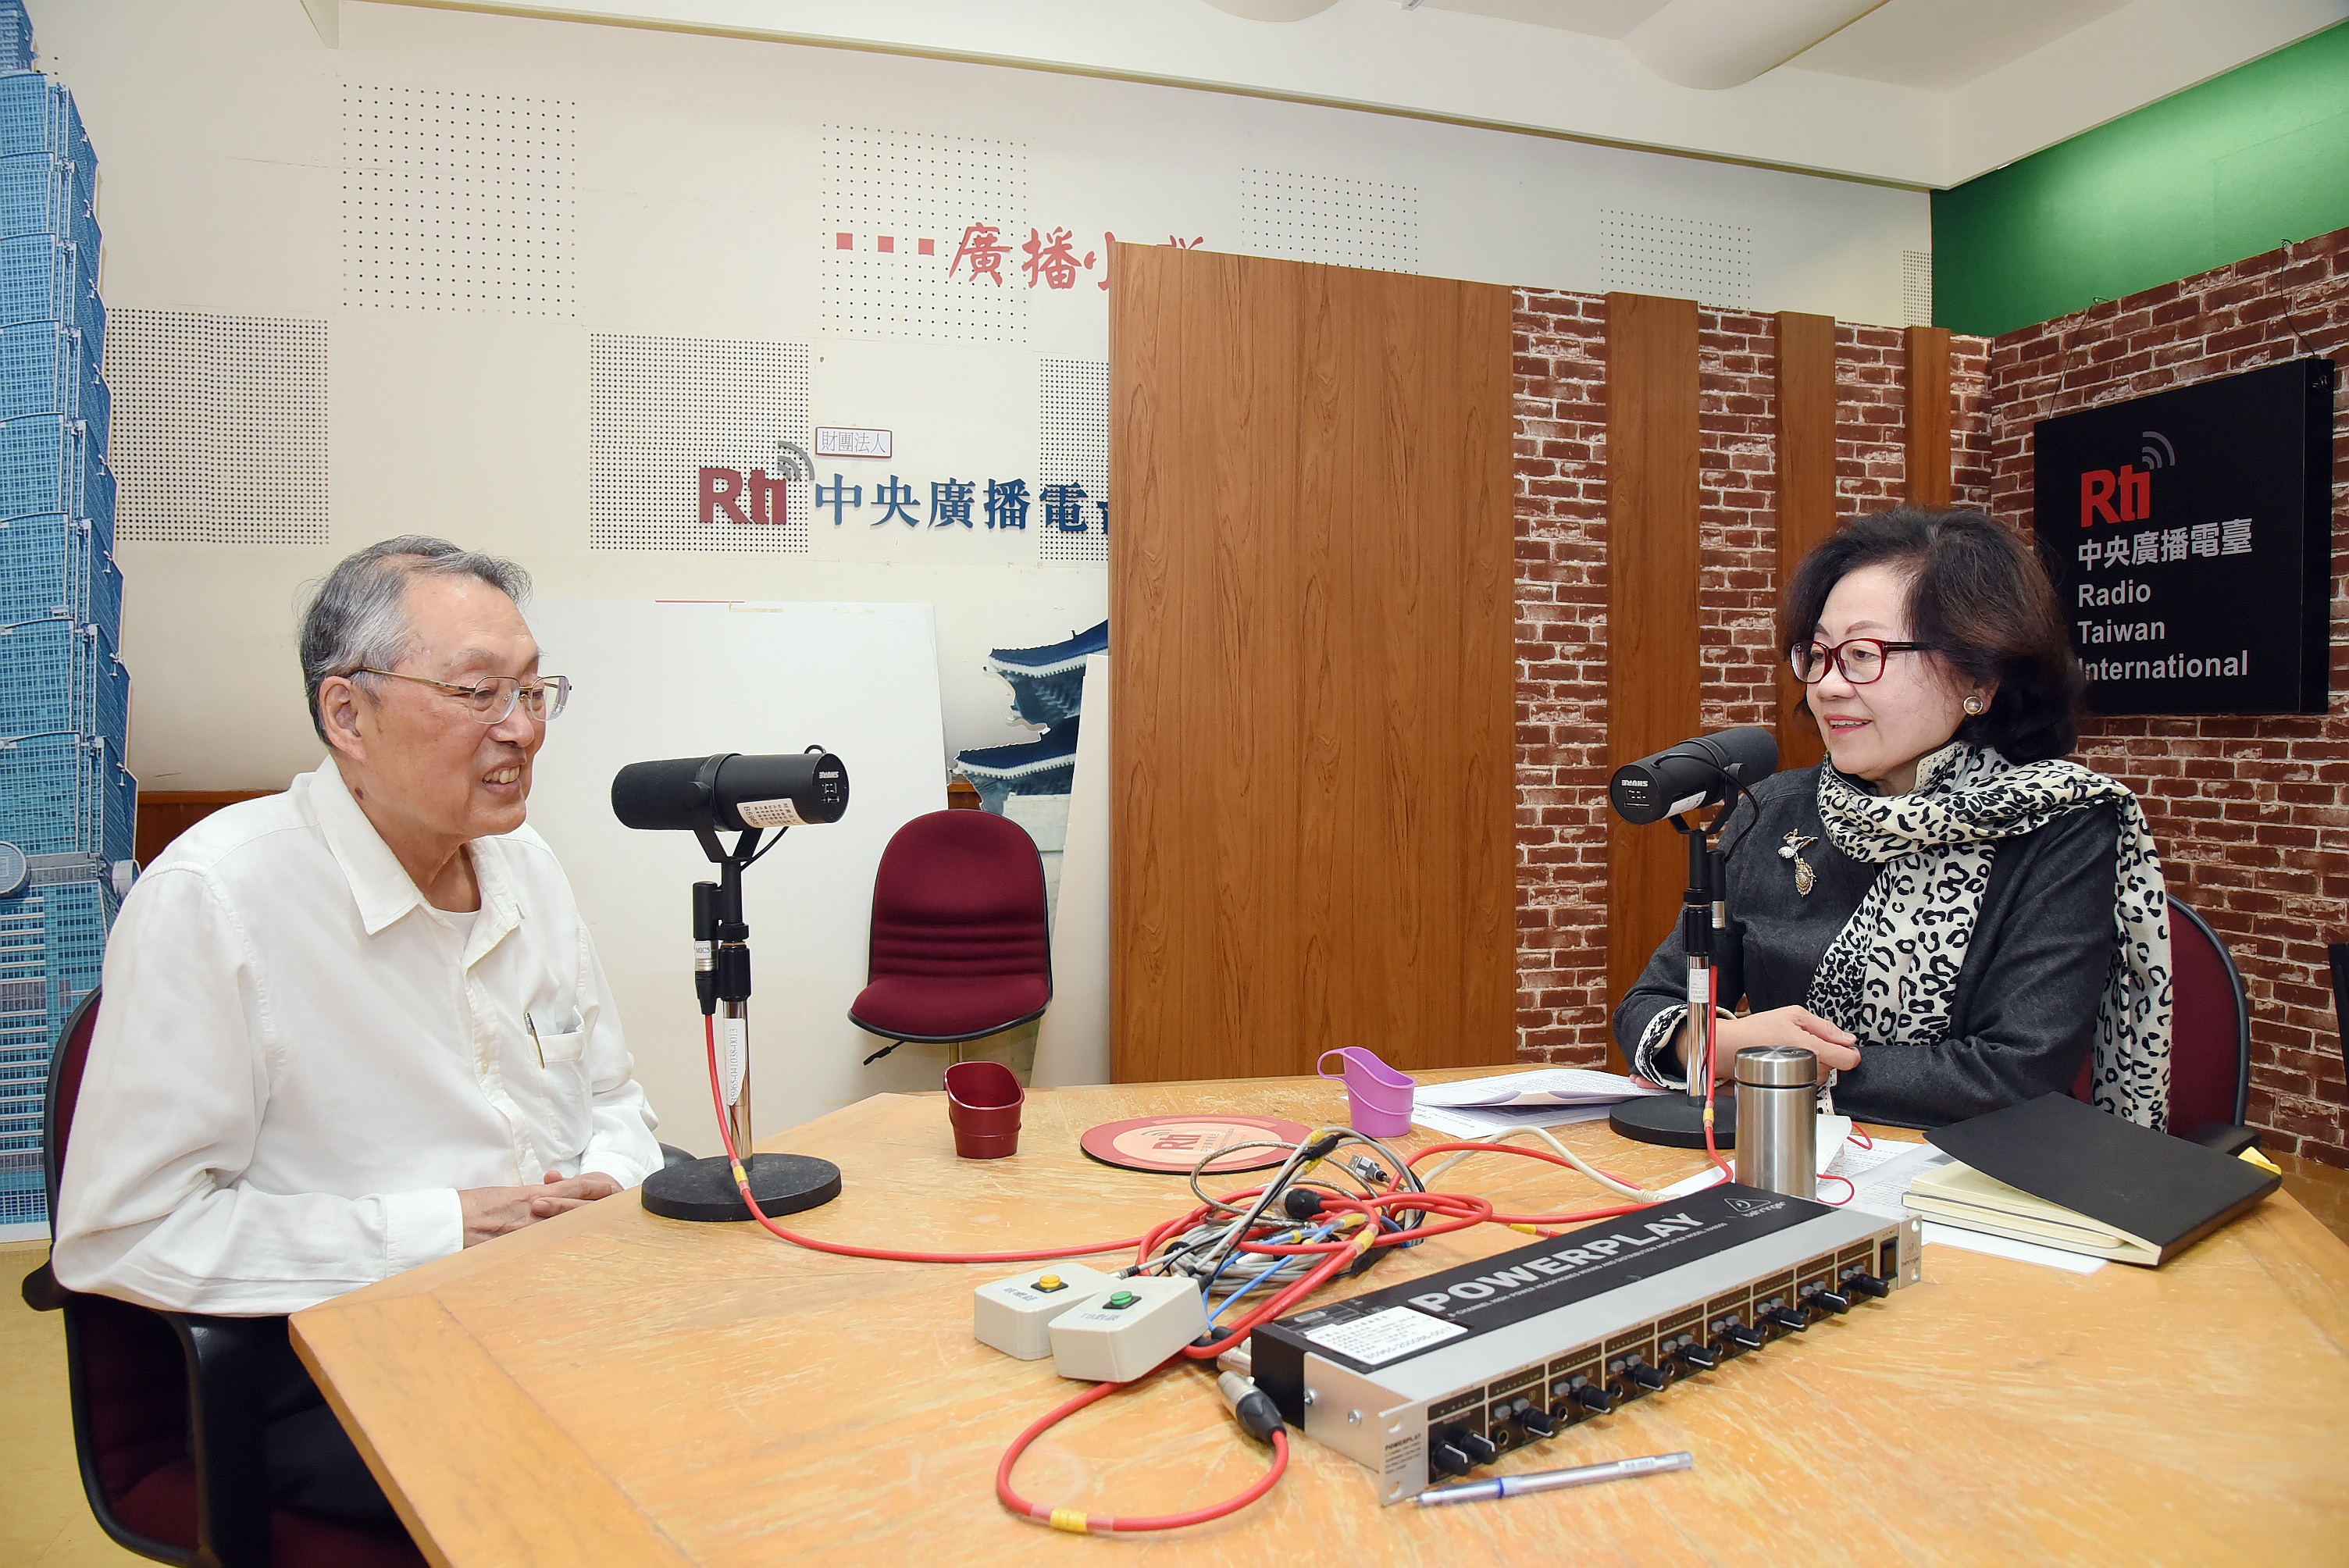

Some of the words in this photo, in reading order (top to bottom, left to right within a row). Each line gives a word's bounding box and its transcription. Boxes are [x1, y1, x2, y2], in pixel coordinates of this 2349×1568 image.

[949, 222, 1203, 290] 廣播小
[822, 431, 886, 454] 財團法人
[815, 473, 1109, 535] 中央廣播電
[2078, 518, 2253, 572] 中央廣播電臺
[2078, 579, 2151, 608] Radio
[2077, 618, 2165, 644] Taiwan
[1741, 1201, 1787, 1217] behringer
[1408, 1213, 1705, 1313] POWERPLAY
